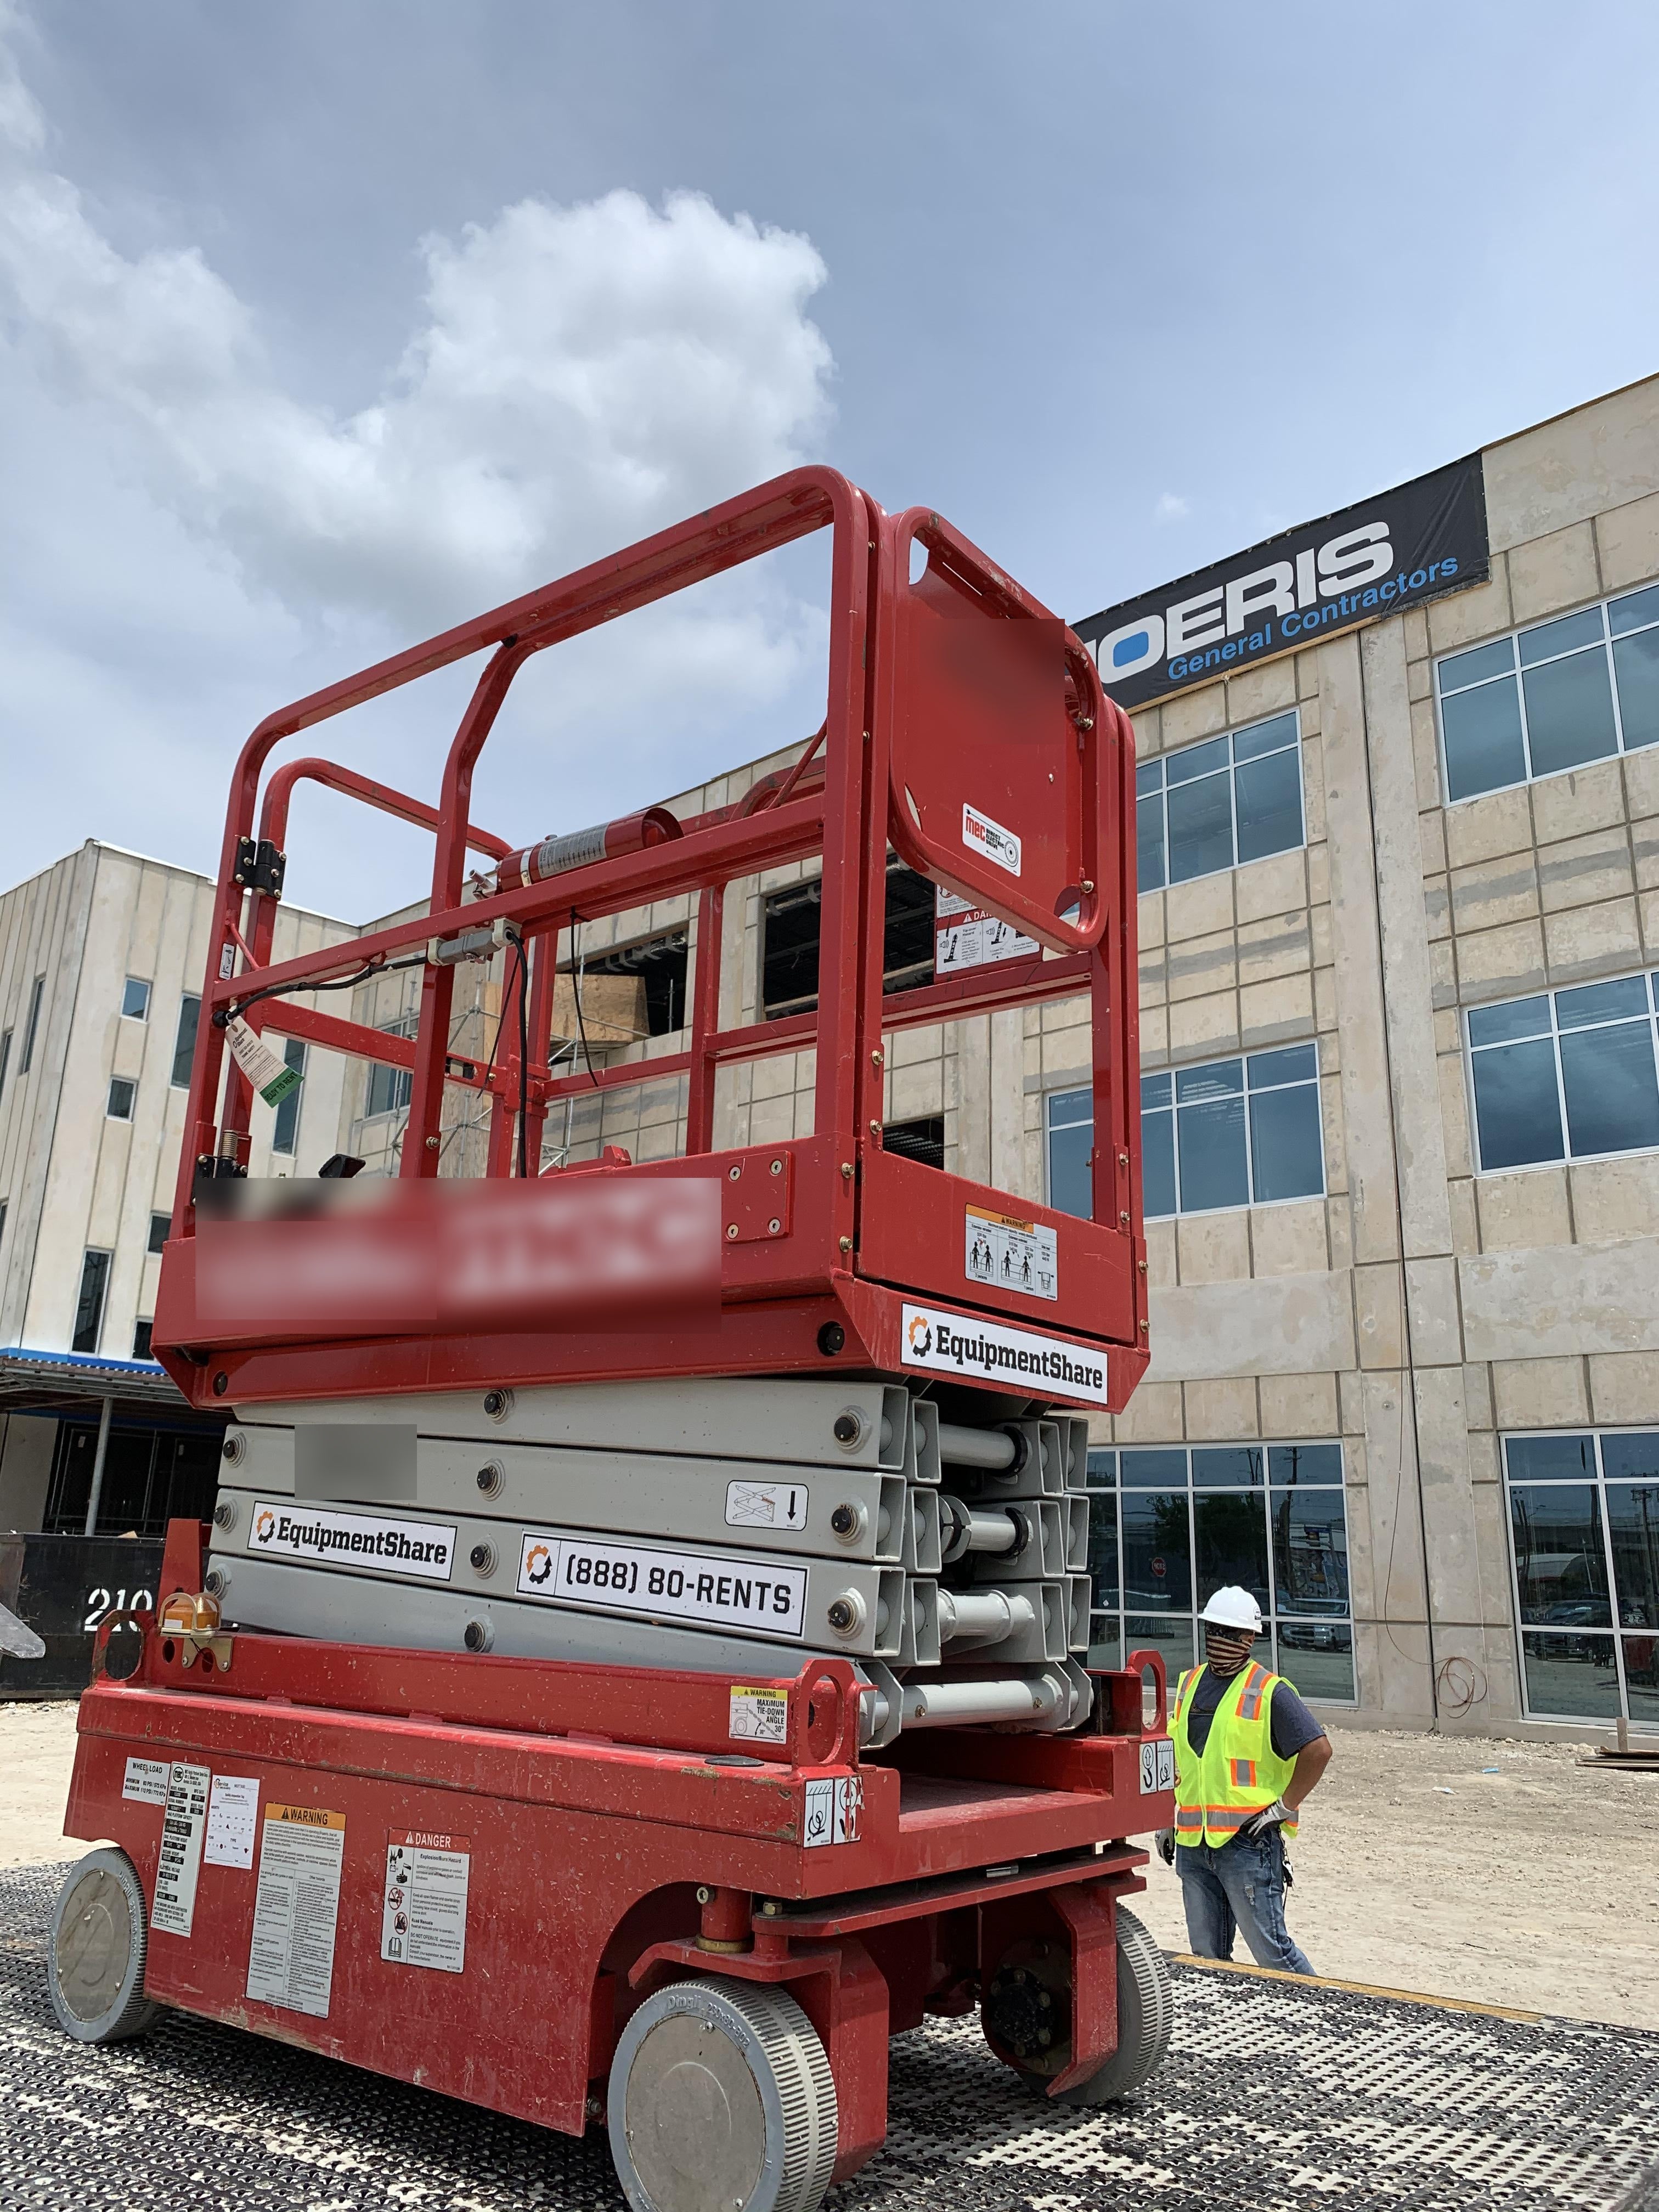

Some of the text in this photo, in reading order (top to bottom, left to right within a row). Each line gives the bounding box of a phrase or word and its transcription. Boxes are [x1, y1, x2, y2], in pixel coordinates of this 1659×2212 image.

[1086, 521, 1393, 684] OERIS
[1168, 556, 1459, 680] General Contractors
[986, 828, 1001, 840] DIRECT
[986, 833, 1005, 848] ELECTRIC
[986, 839, 998, 850] DRIVE
[264, 1087, 279, 1102] READY
[283, 1071, 298, 1085] RENT
[1005, 1217, 1026, 1229] WARNING
[936, 1325, 1103, 1389] EquipmentShare
[277, 1517, 447, 1564] EquipmentShare
[566, 1554, 791, 1615] (888) 80-RENTS
[751, 1689, 776, 1697] WARNING
[757, 1707, 785, 1717] TIE-DOWN
[766, 1716, 785, 1724] ANGLE
[149, 1765, 162, 1774] LOAD
[291, 1808, 328, 1825] WARNING
[415, 1833, 452, 1848] DANGER
[667, 1994, 701, 2009] Dingli
